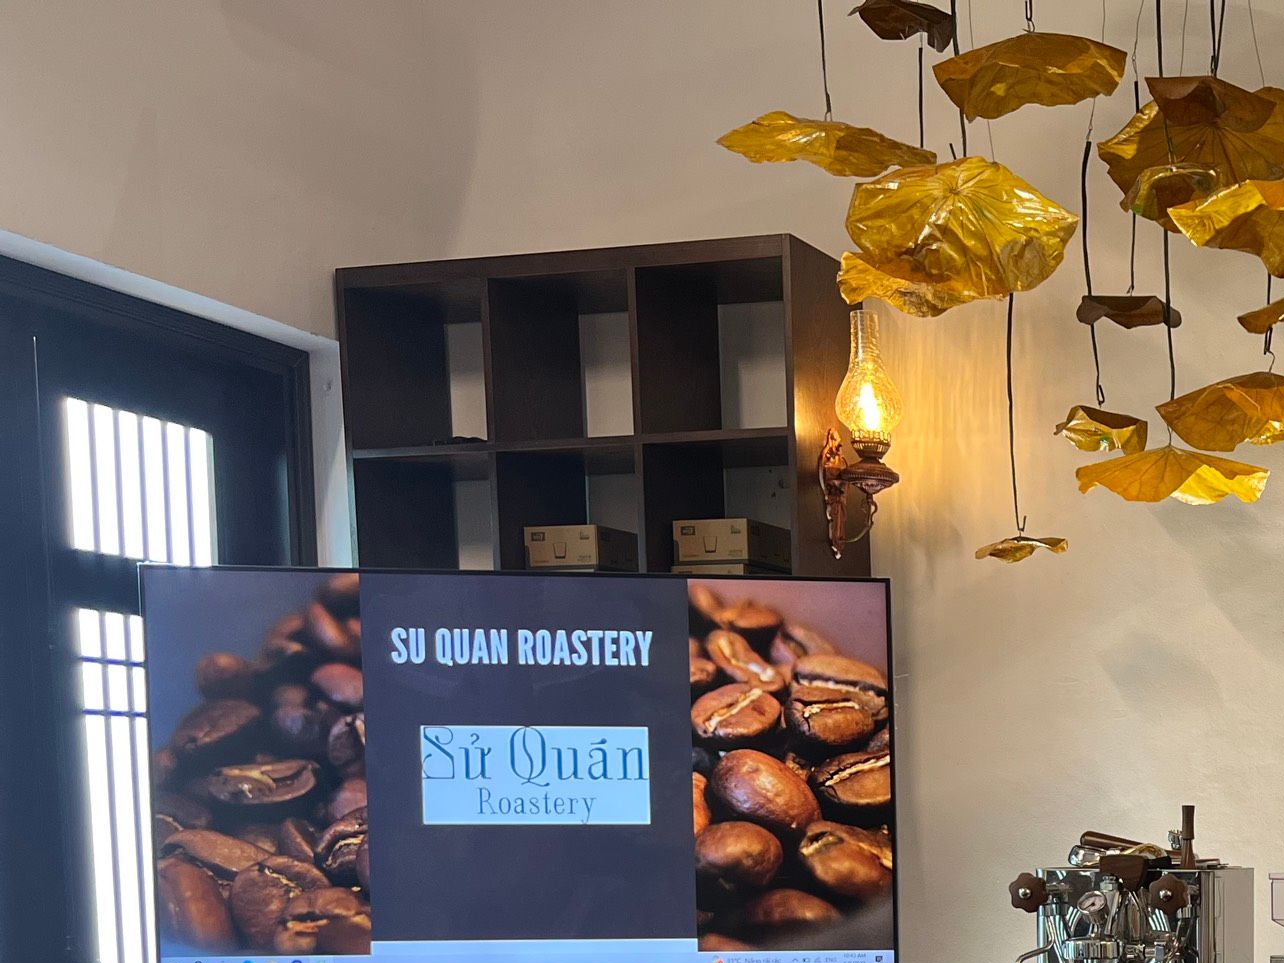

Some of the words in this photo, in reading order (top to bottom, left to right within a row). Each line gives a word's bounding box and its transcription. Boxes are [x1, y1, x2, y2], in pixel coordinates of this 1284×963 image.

[391, 627, 426, 664] SU
[435, 628, 508, 666] QUAN
[518, 629, 653, 666] ROASTERY
[422, 726, 492, 780] Sử
[510, 726, 650, 787] Quán
[477, 787, 597, 824] Roastery
